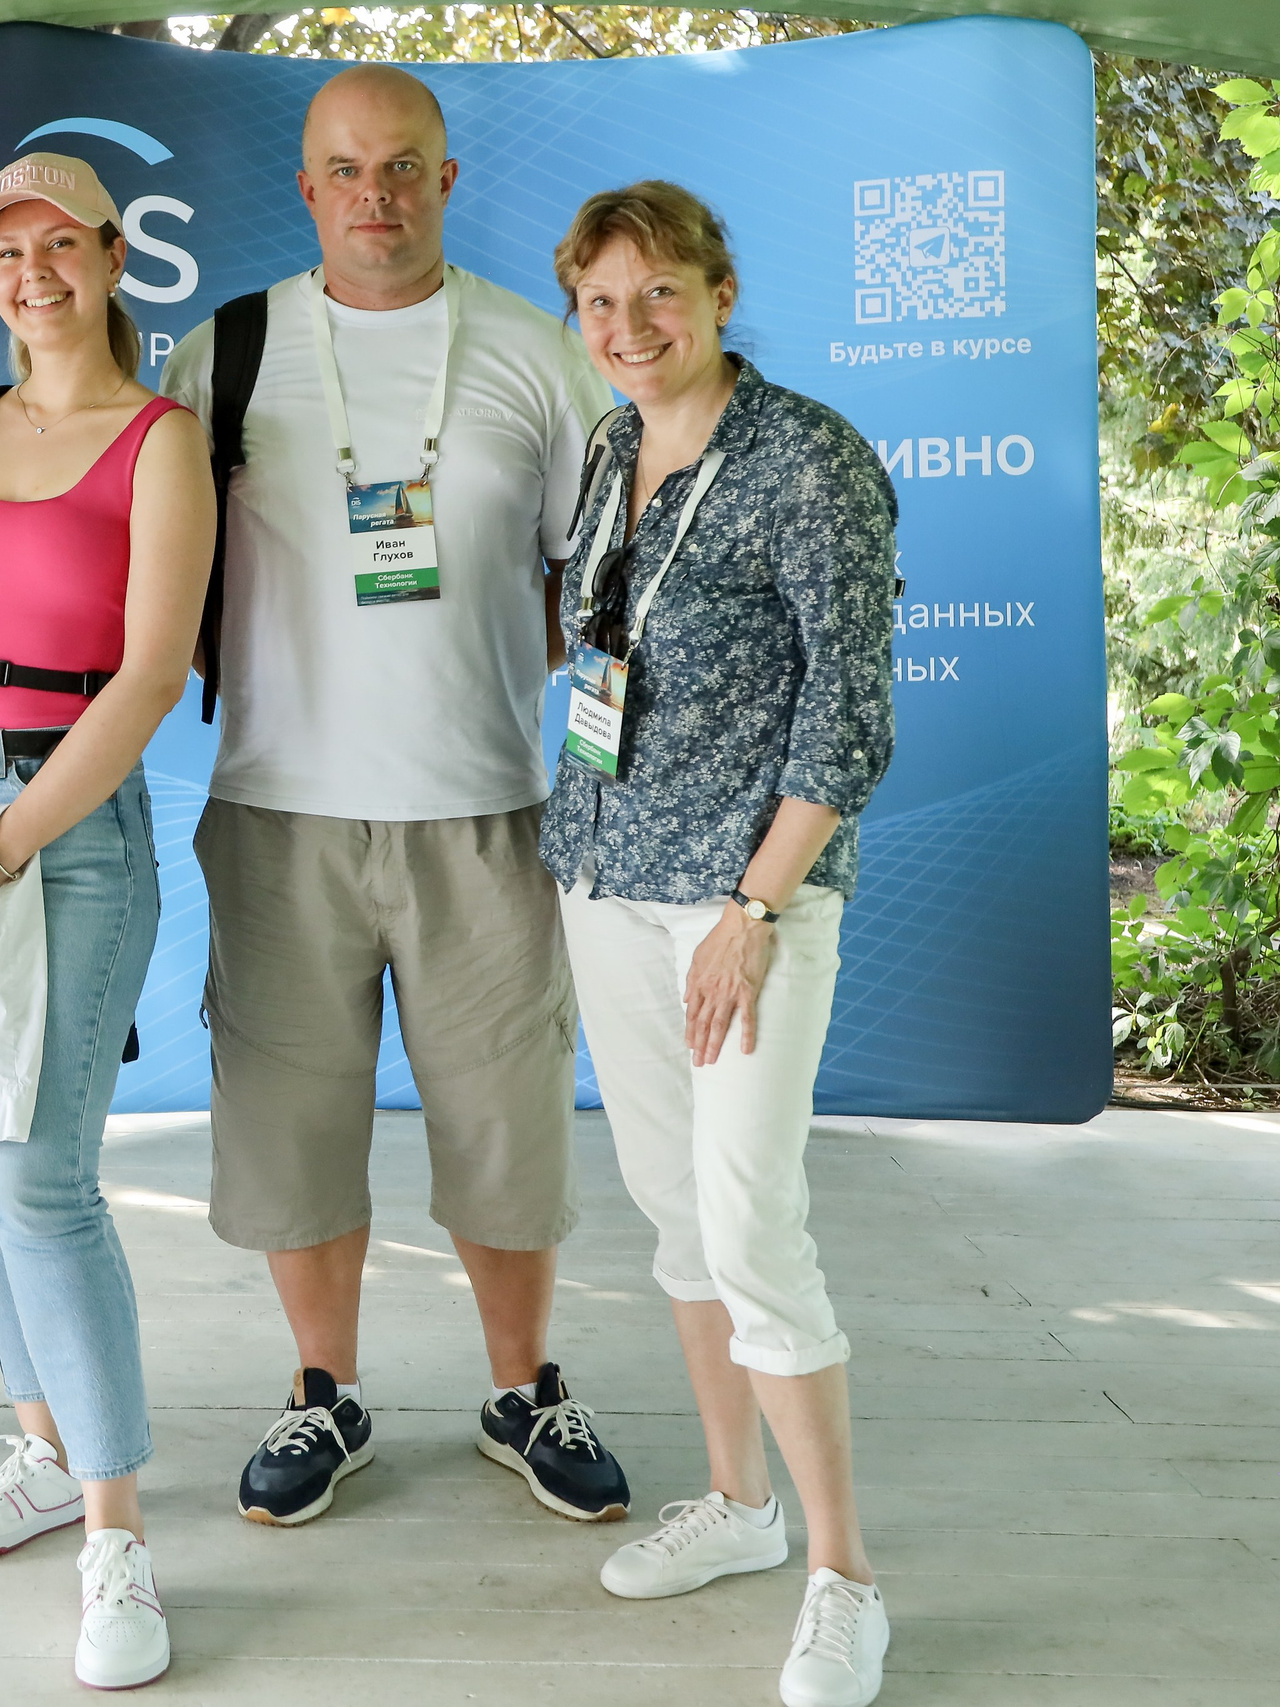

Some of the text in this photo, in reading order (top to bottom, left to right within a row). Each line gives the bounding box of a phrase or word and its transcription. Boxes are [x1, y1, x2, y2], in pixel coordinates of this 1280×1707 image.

[830, 337, 1032, 367] Будьте в курсе
[869, 434, 1035, 479] ИВНО
[353, 512, 387, 521] Парусная
[370, 519, 394, 528] регата
[376, 540, 406, 549] Иван
[373, 551, 414, 562] Глухов
[377, 573, 414, 582] Сбербанк
[374, 580, 417, 589] Технологии
[577, 702, 612, 727] Людмила
[574, 713, 612, 740] Давыдова
